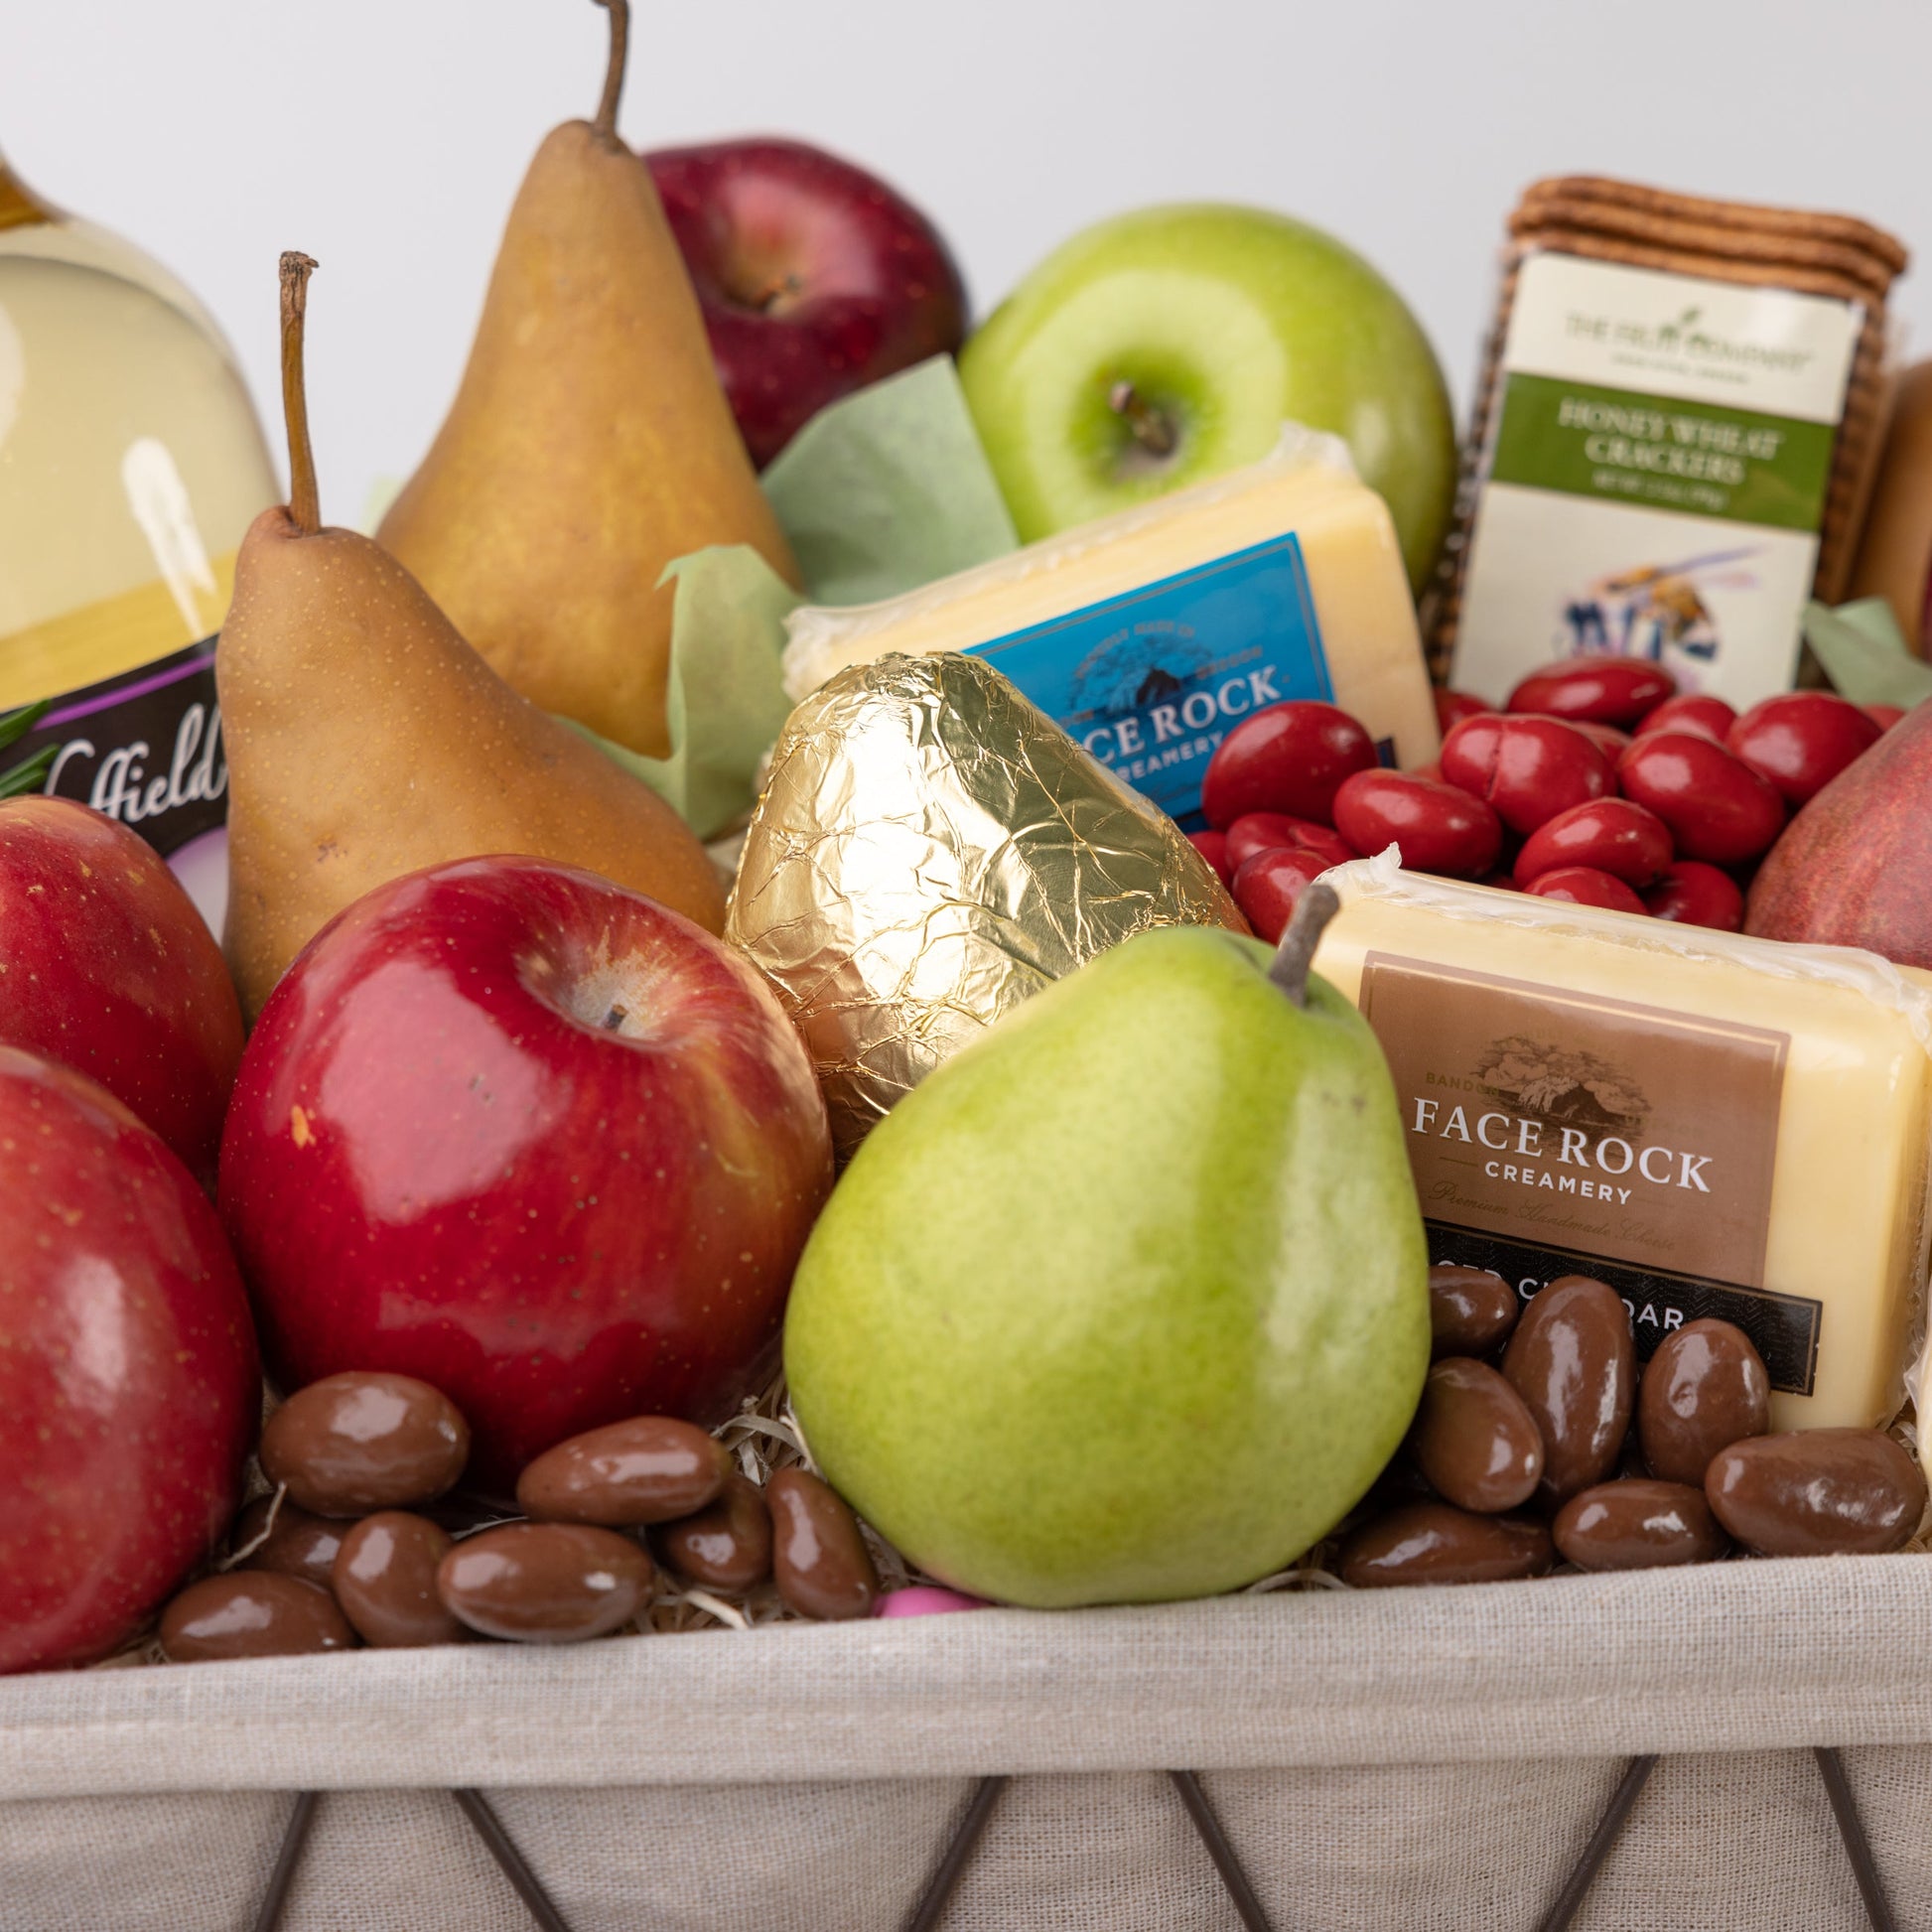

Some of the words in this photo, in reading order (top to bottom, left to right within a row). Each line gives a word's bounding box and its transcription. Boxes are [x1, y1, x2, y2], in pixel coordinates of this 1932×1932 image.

[1558, 396, 1666, 442] HONEY
[1669, 416, 1785, 461] WHEAT
[1584, 434, 1746, 485] CRACKERS
[1083, 717, 1145, 764] CE
[1149, 664, 1283, 744] ROCK
[1116, 731, 1224, 783] REAMERY
[1412, 1097, 1543, 1159] FACE
[1556, 1127, 1714, 1193] ROCK
[1484, 1161, 1633, 1205] CREAMERY
